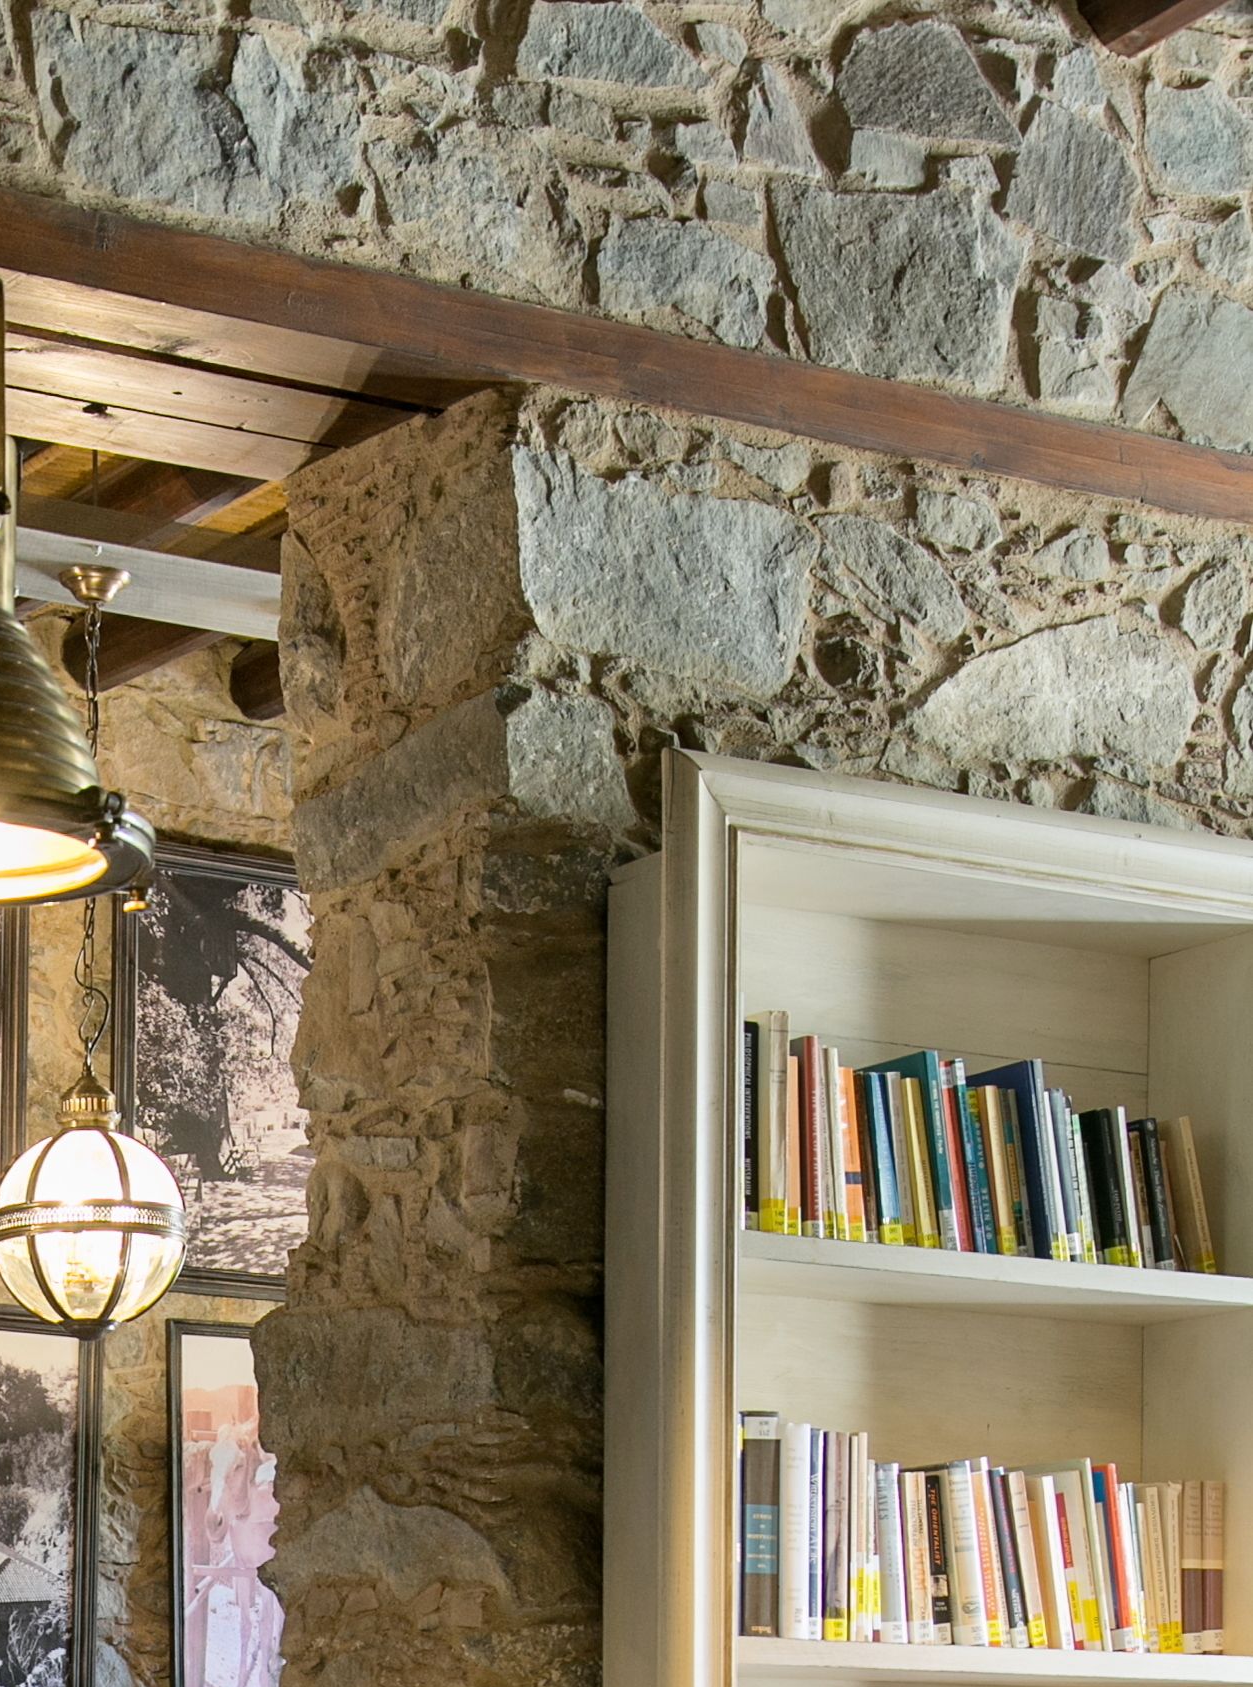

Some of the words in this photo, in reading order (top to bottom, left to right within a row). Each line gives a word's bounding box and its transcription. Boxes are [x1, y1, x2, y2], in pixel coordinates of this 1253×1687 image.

[744, 1033, 752, 1085] PHILOSOPHICAL
[929, 1488, 937, 1506] THE
[931, 1508, 942, 1565] ORIENTALIST
